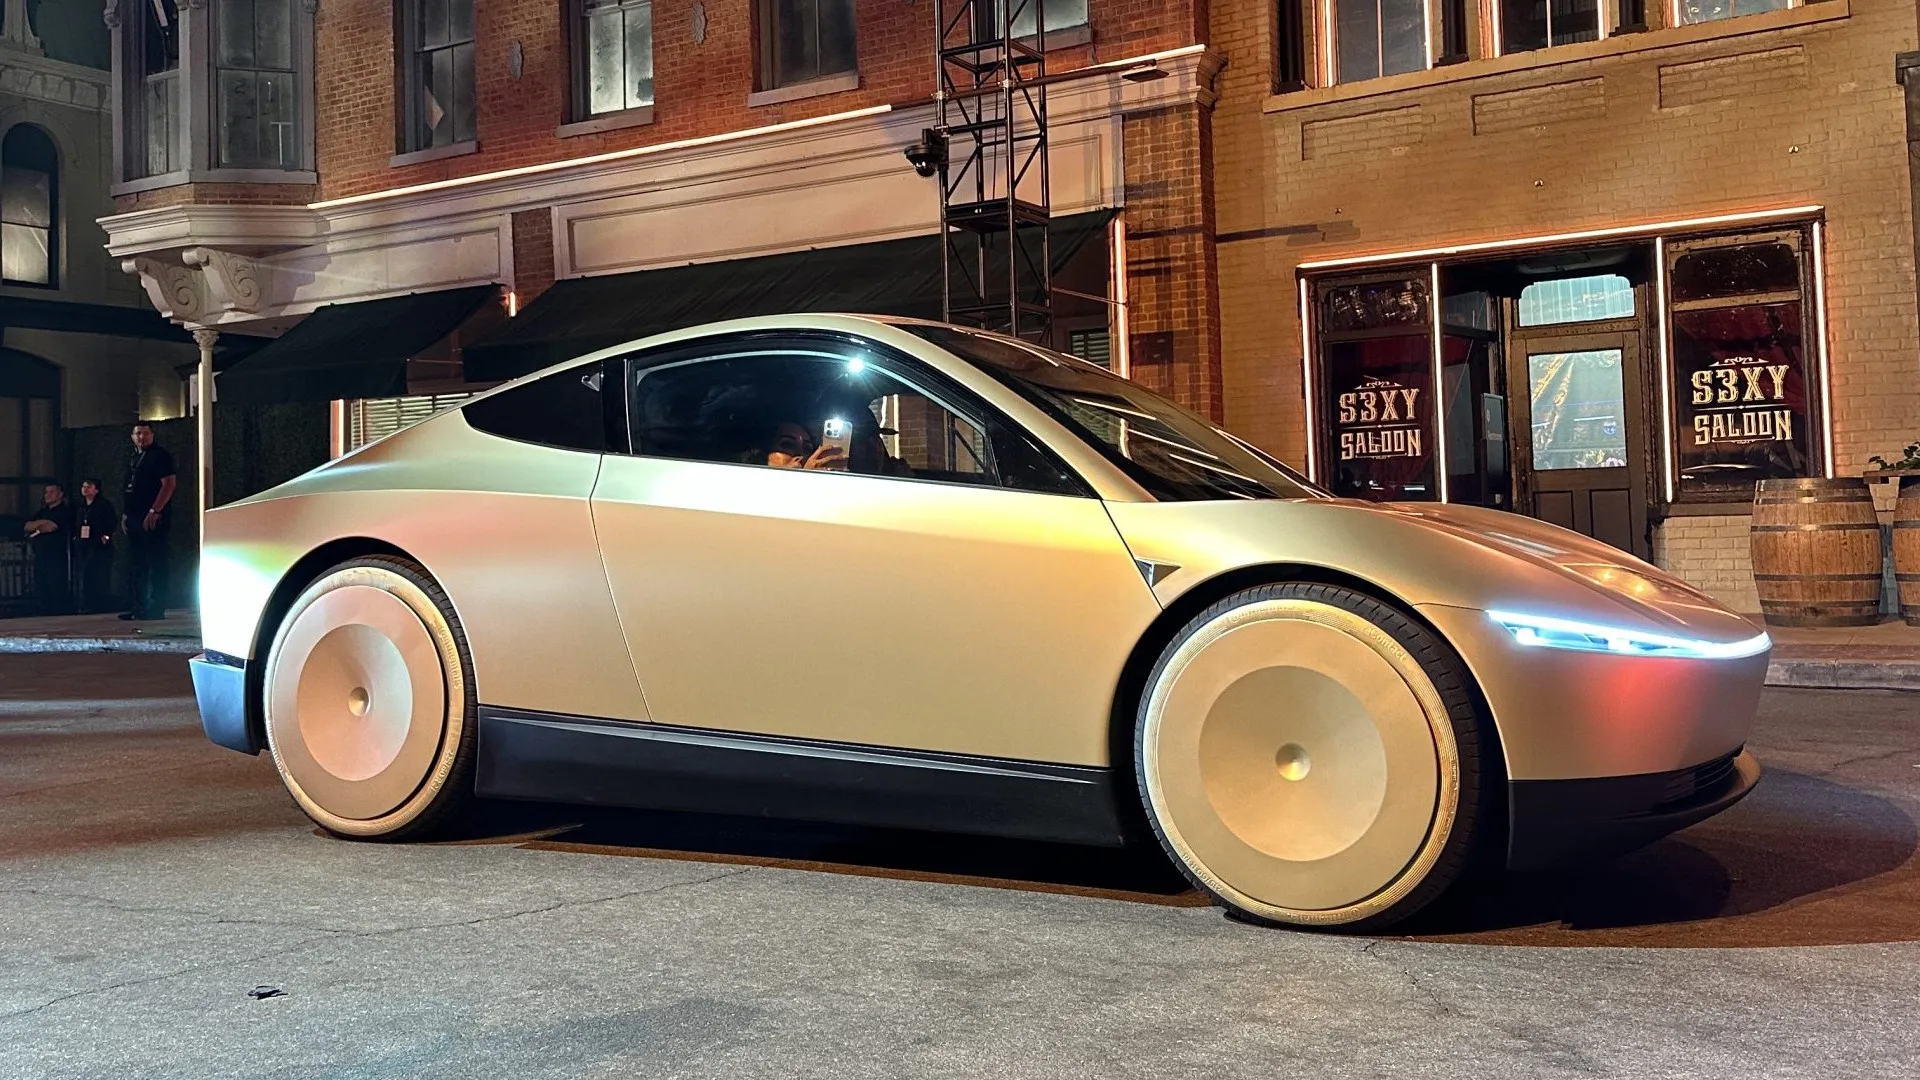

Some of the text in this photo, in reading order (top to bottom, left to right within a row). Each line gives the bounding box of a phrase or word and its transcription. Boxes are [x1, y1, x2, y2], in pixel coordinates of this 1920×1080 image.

[1691, 365, 1789, 404] S3XY
[1339, 388, 1419, 424] S3XY
[1341, 429, 1421, 460] SALOON
[1694, 410, 1793, 445] SALOON
